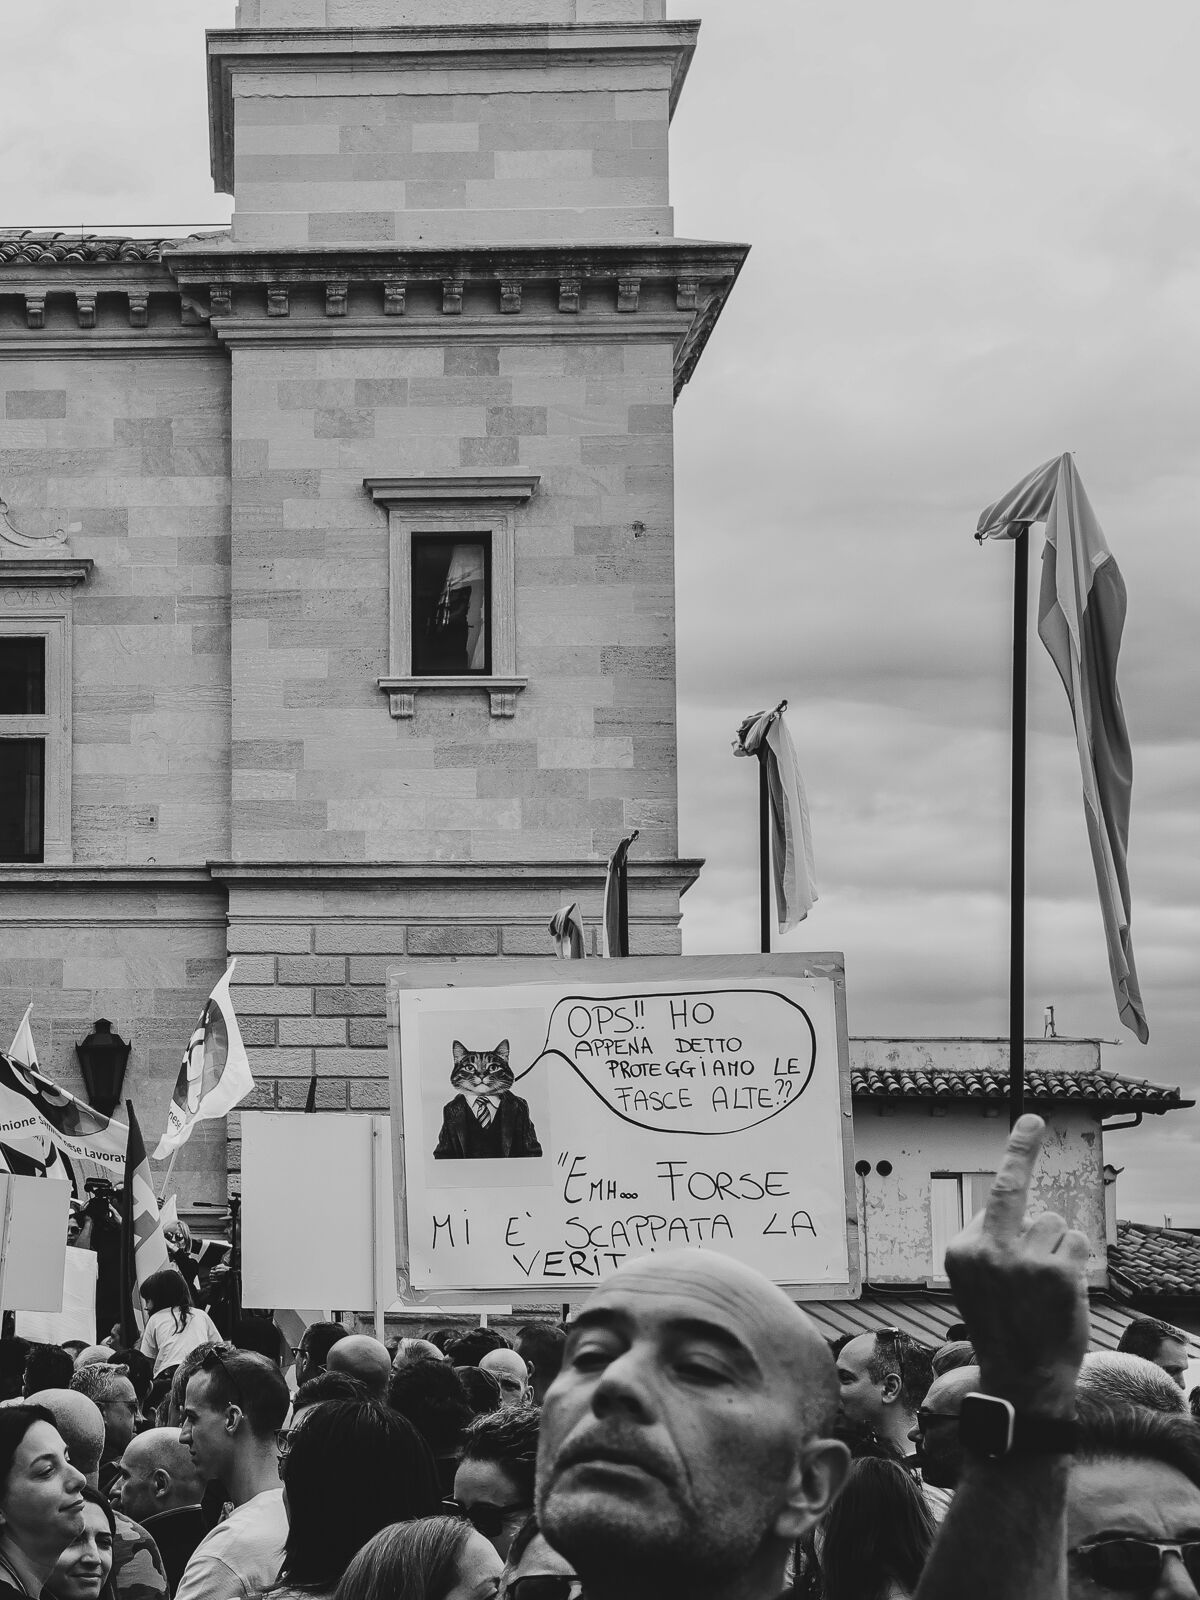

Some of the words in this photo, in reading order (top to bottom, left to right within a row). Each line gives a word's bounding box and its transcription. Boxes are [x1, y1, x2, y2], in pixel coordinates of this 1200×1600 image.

[567, 999, 646, 1039] OPS!!
[669, 998, 715, 1030] HO
[574, 1036, 654, 1060] APPENA
[674, 1036, 743, 1054] DETTO
[773, 1057, 801, 1076] LE
[613, 1086, 693, 1112] FASCE
[711, 1078, 793, 1113] ALTE??
[656, 1160, 791, 1202] FORSE
[564, 1213, 734, 1250] SCAPPATA
[762, 1210, 818, 1238] LA
[512, 1249, 628, 1278] VERIT
